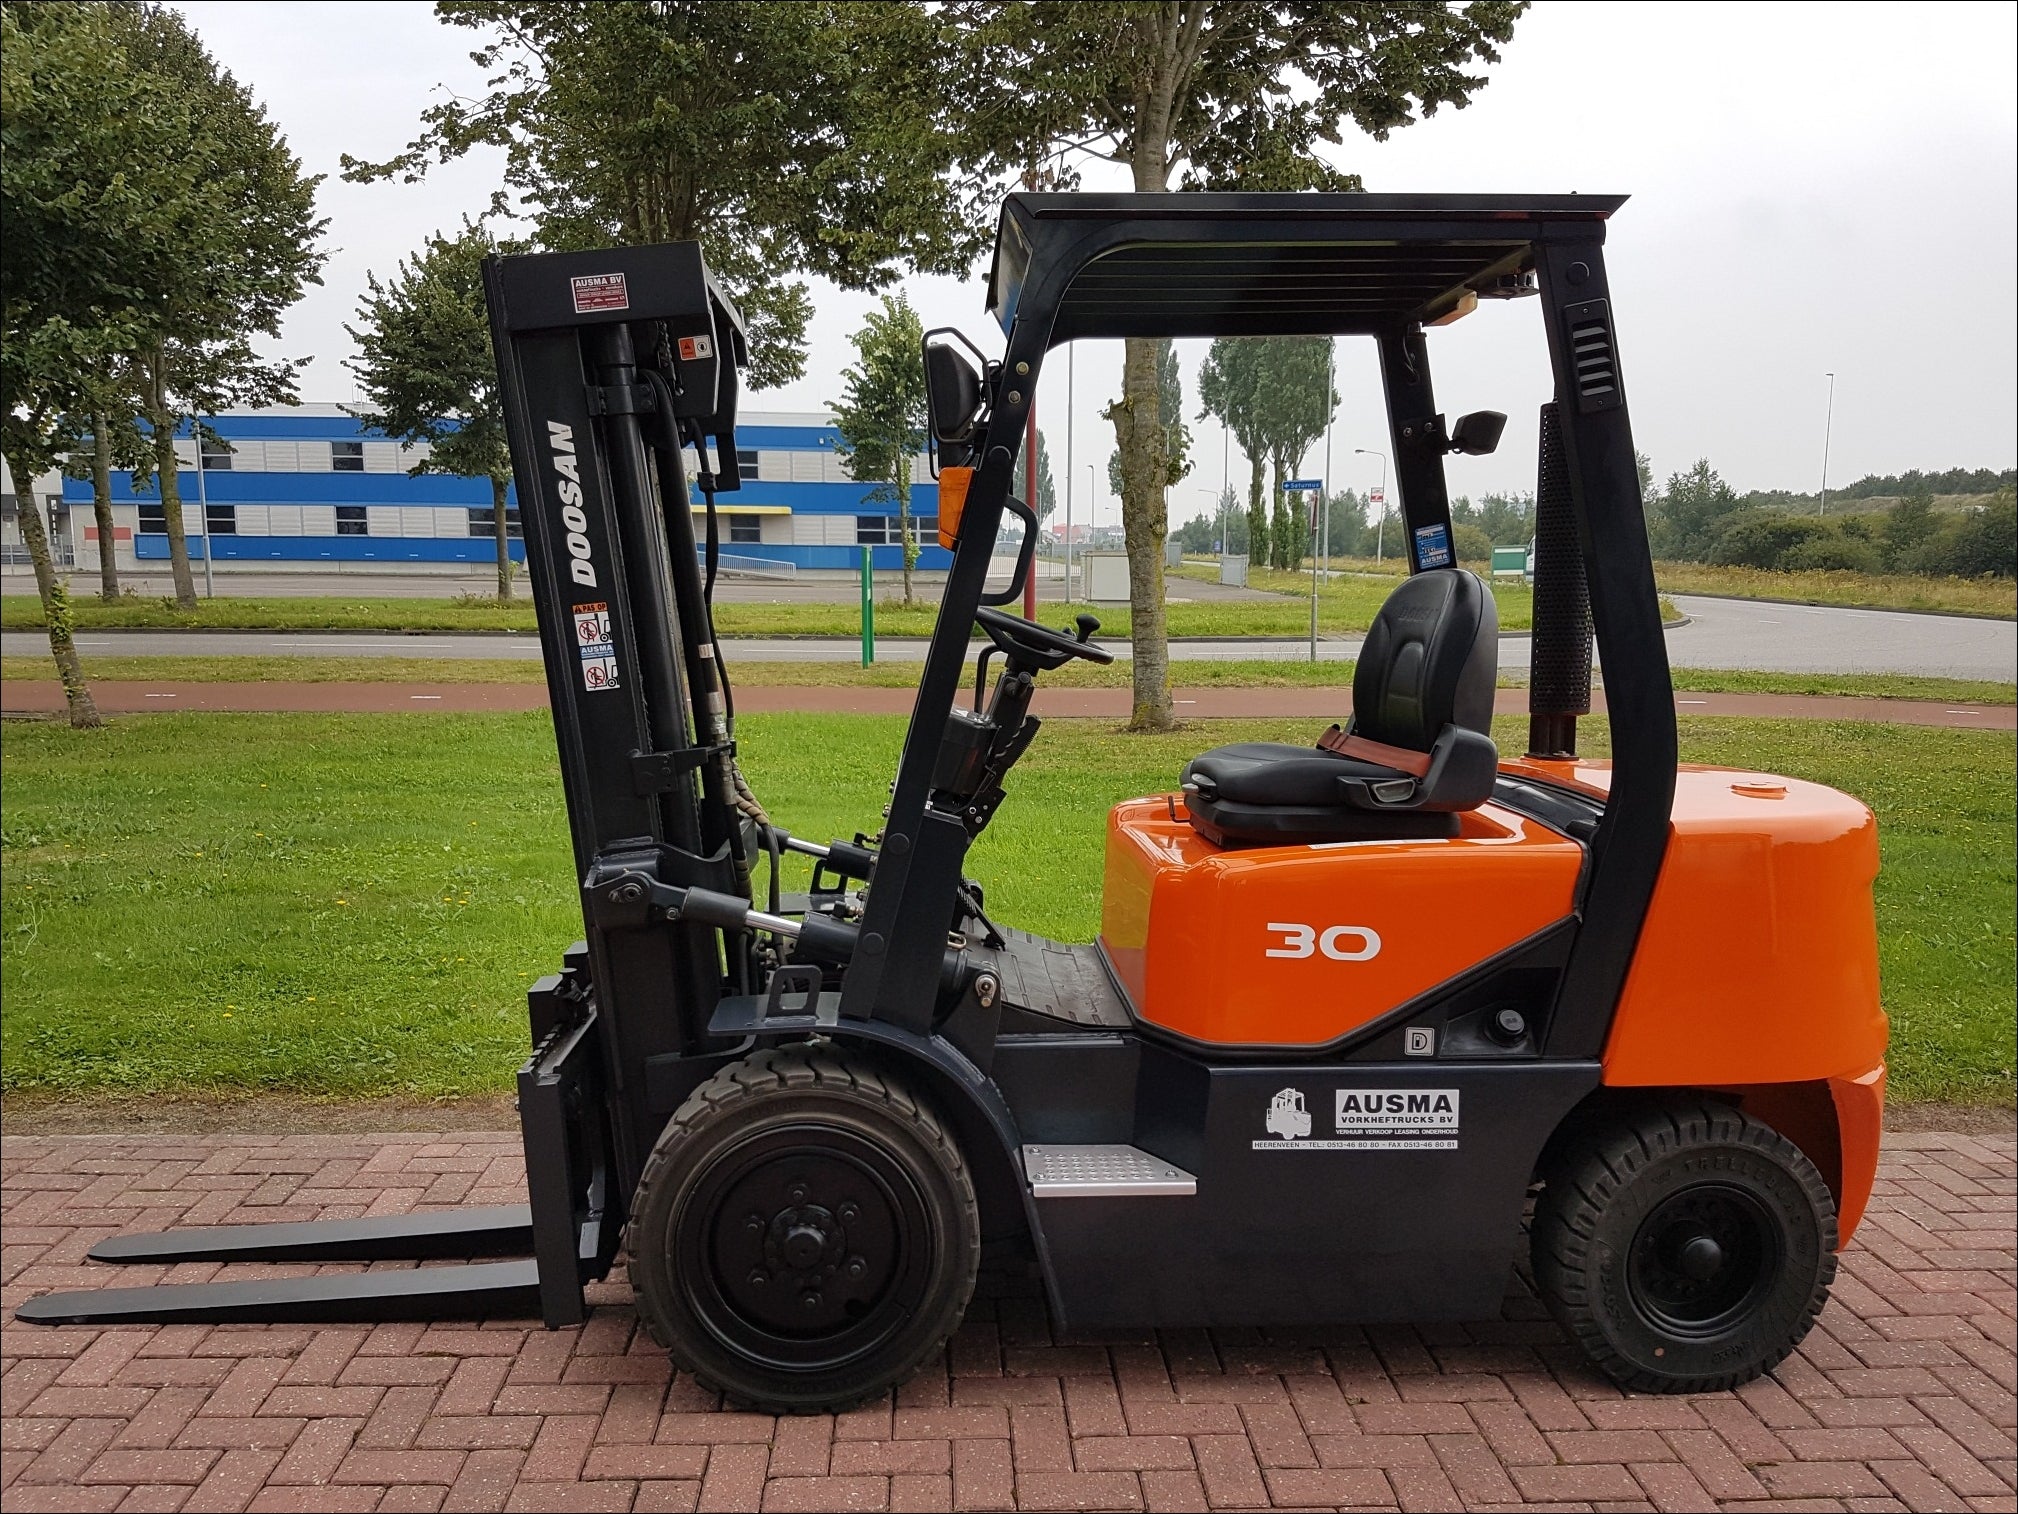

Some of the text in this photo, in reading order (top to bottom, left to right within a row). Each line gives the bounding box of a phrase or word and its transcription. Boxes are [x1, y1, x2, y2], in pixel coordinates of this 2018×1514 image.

[576, 276, 621, 287] AUSMA BV
[547, 420, 598, 588] DOOSAN
[1421, 554, 1447, 564] AUSMA
[583, 603, 606, 612] PAS OP
[581, 644, 613, 654] AUSMA
[1265, 922, 1382, 962] 30
[1341, 1094, 1453, 1114] AUSMA
[1341, 1115, 1454, 1124] VORKHEFTRUCKS BV
